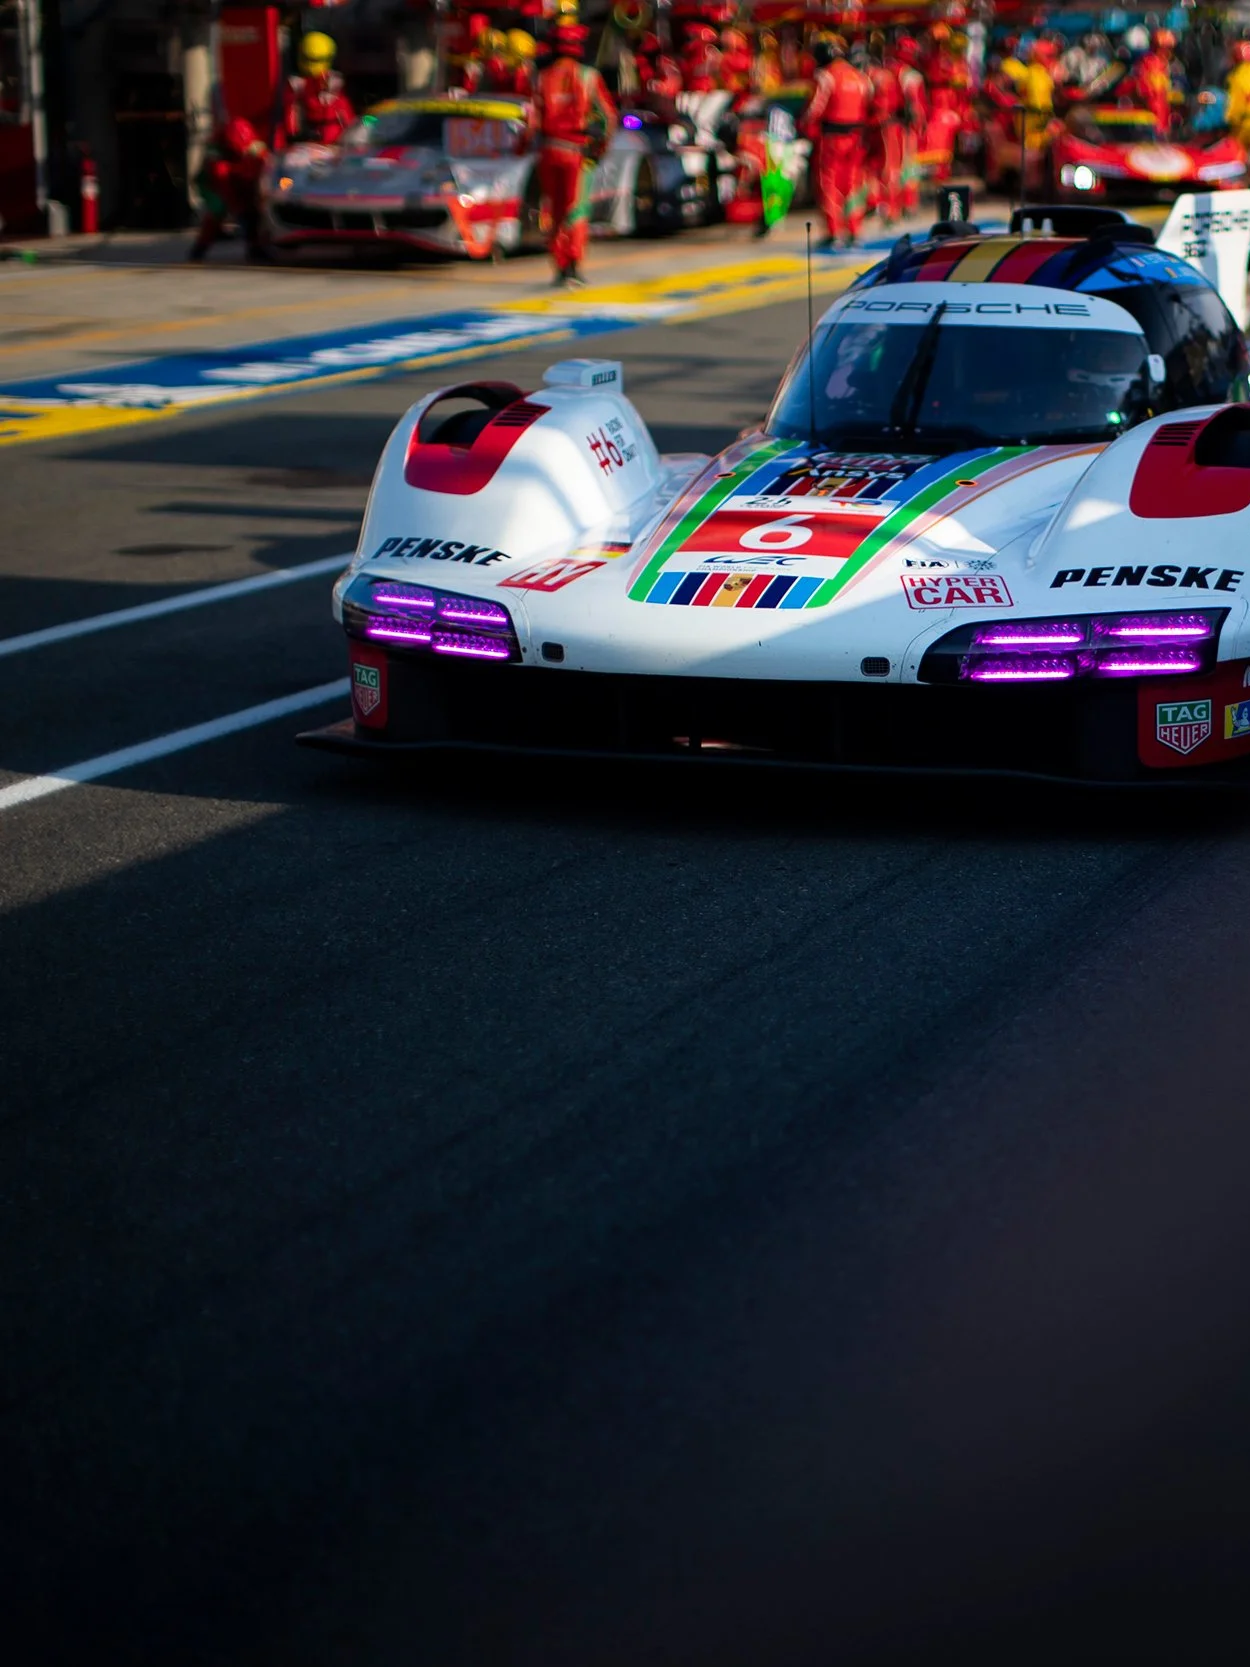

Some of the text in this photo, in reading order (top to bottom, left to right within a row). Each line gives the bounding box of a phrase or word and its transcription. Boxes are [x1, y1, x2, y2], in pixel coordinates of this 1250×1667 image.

[844, 299, 1091, 317] PORSCHE
[586, 427, 624, 477] #6
[787, 467, 907, 480] Ansys
[738, 513, 816, 551] 6
[371, 537, 512, 567] PENSKE
[904, 559, 944, 569] FIA
[909, 576, 998, 588] HYPER
[1050, 565, 1245, 592] PENSKE
[913, 586, 1005, 606] CAR
[354, 667, 377, 687] TAG
[1161, 704, 1207, 722] TAG
[1159, 723, 1208, 750] HEUER
